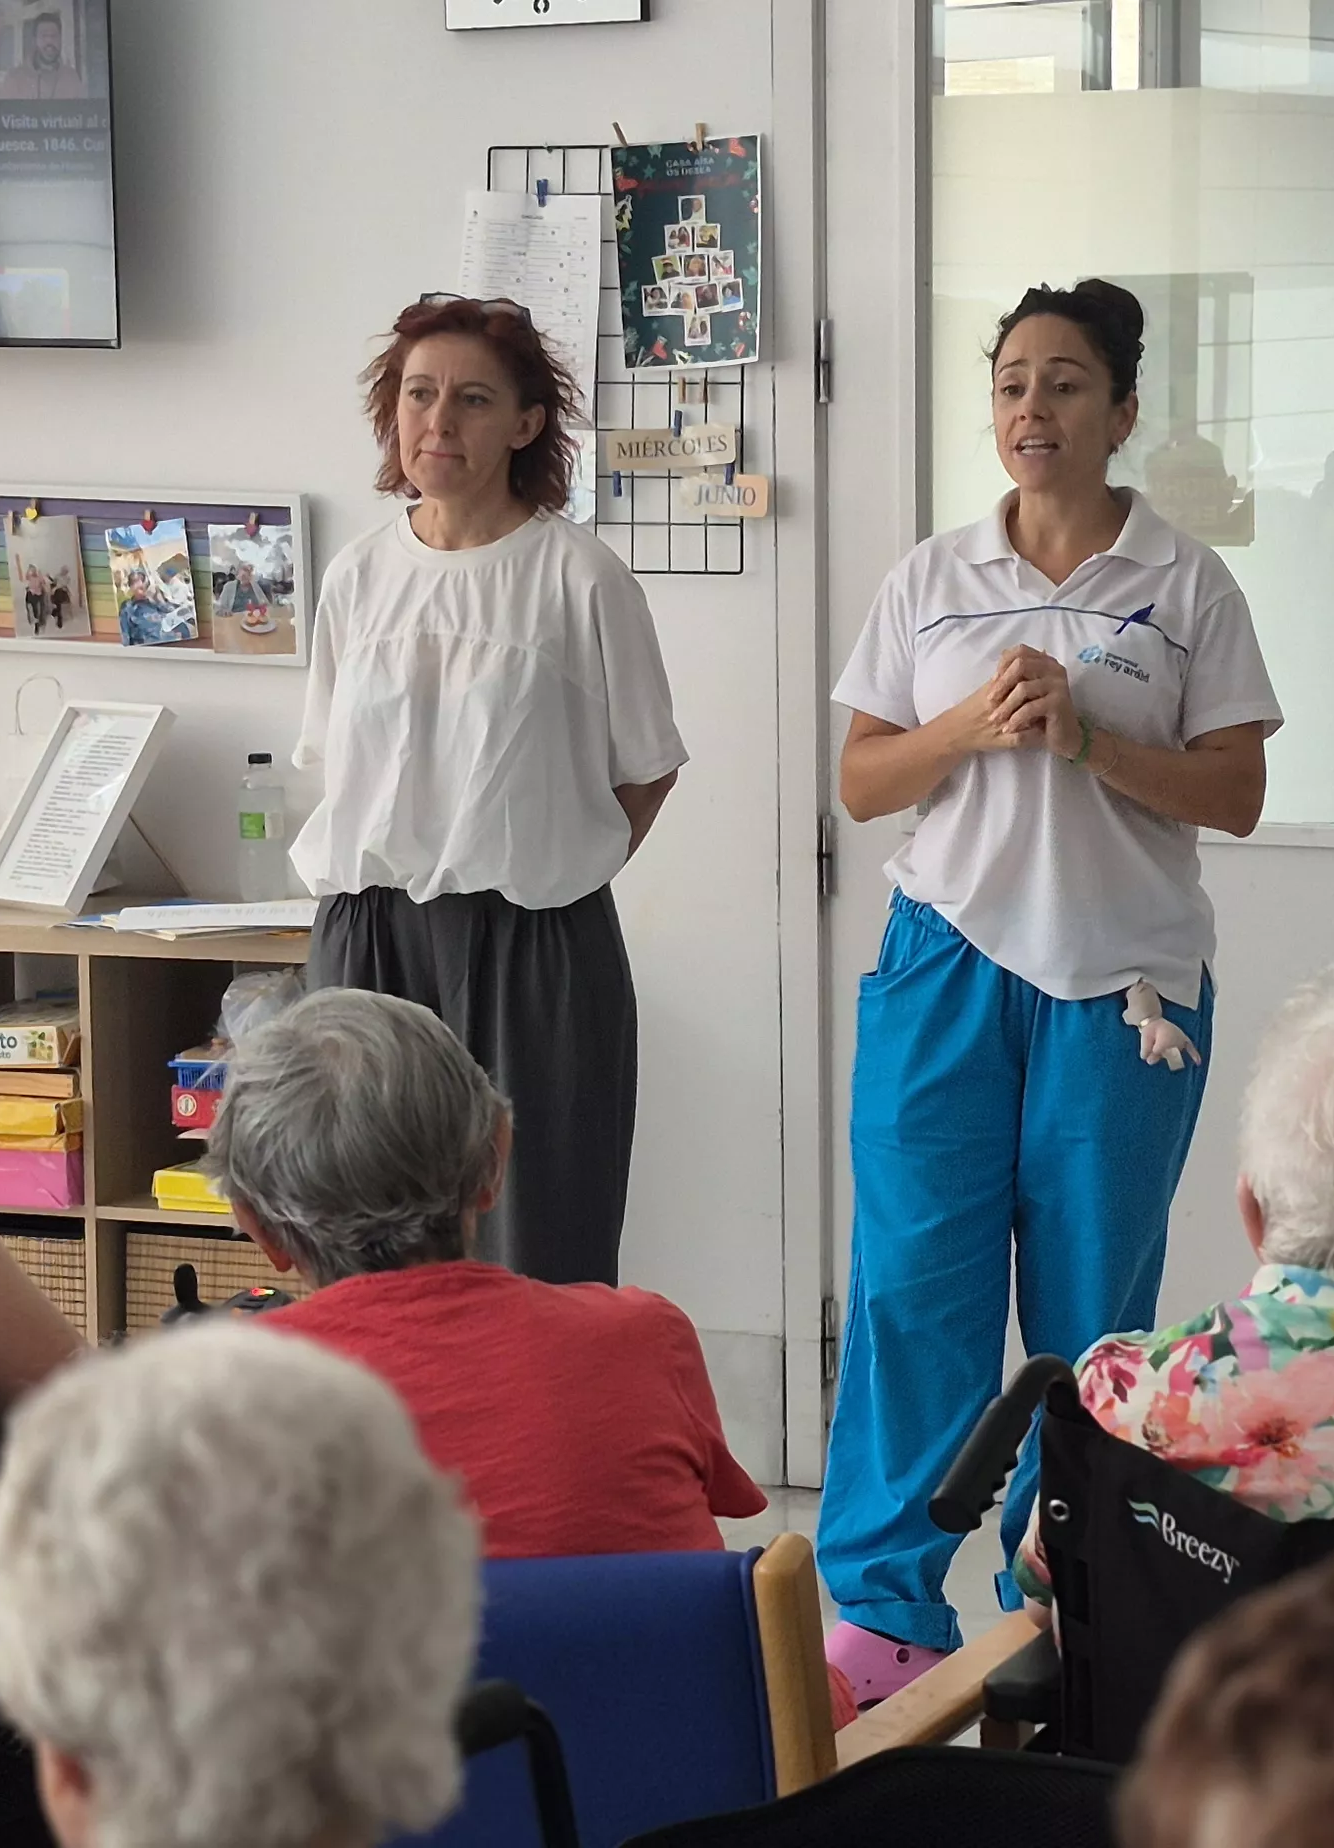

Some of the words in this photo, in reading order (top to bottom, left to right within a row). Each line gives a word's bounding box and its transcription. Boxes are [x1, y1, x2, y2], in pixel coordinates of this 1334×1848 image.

[1, 114, 38, 129] Visita
[42, 113, 84, 129] virtual
[693, 484, 757, 507] JUNIO
[1161, 1511, 1237, 1585] Breezy
